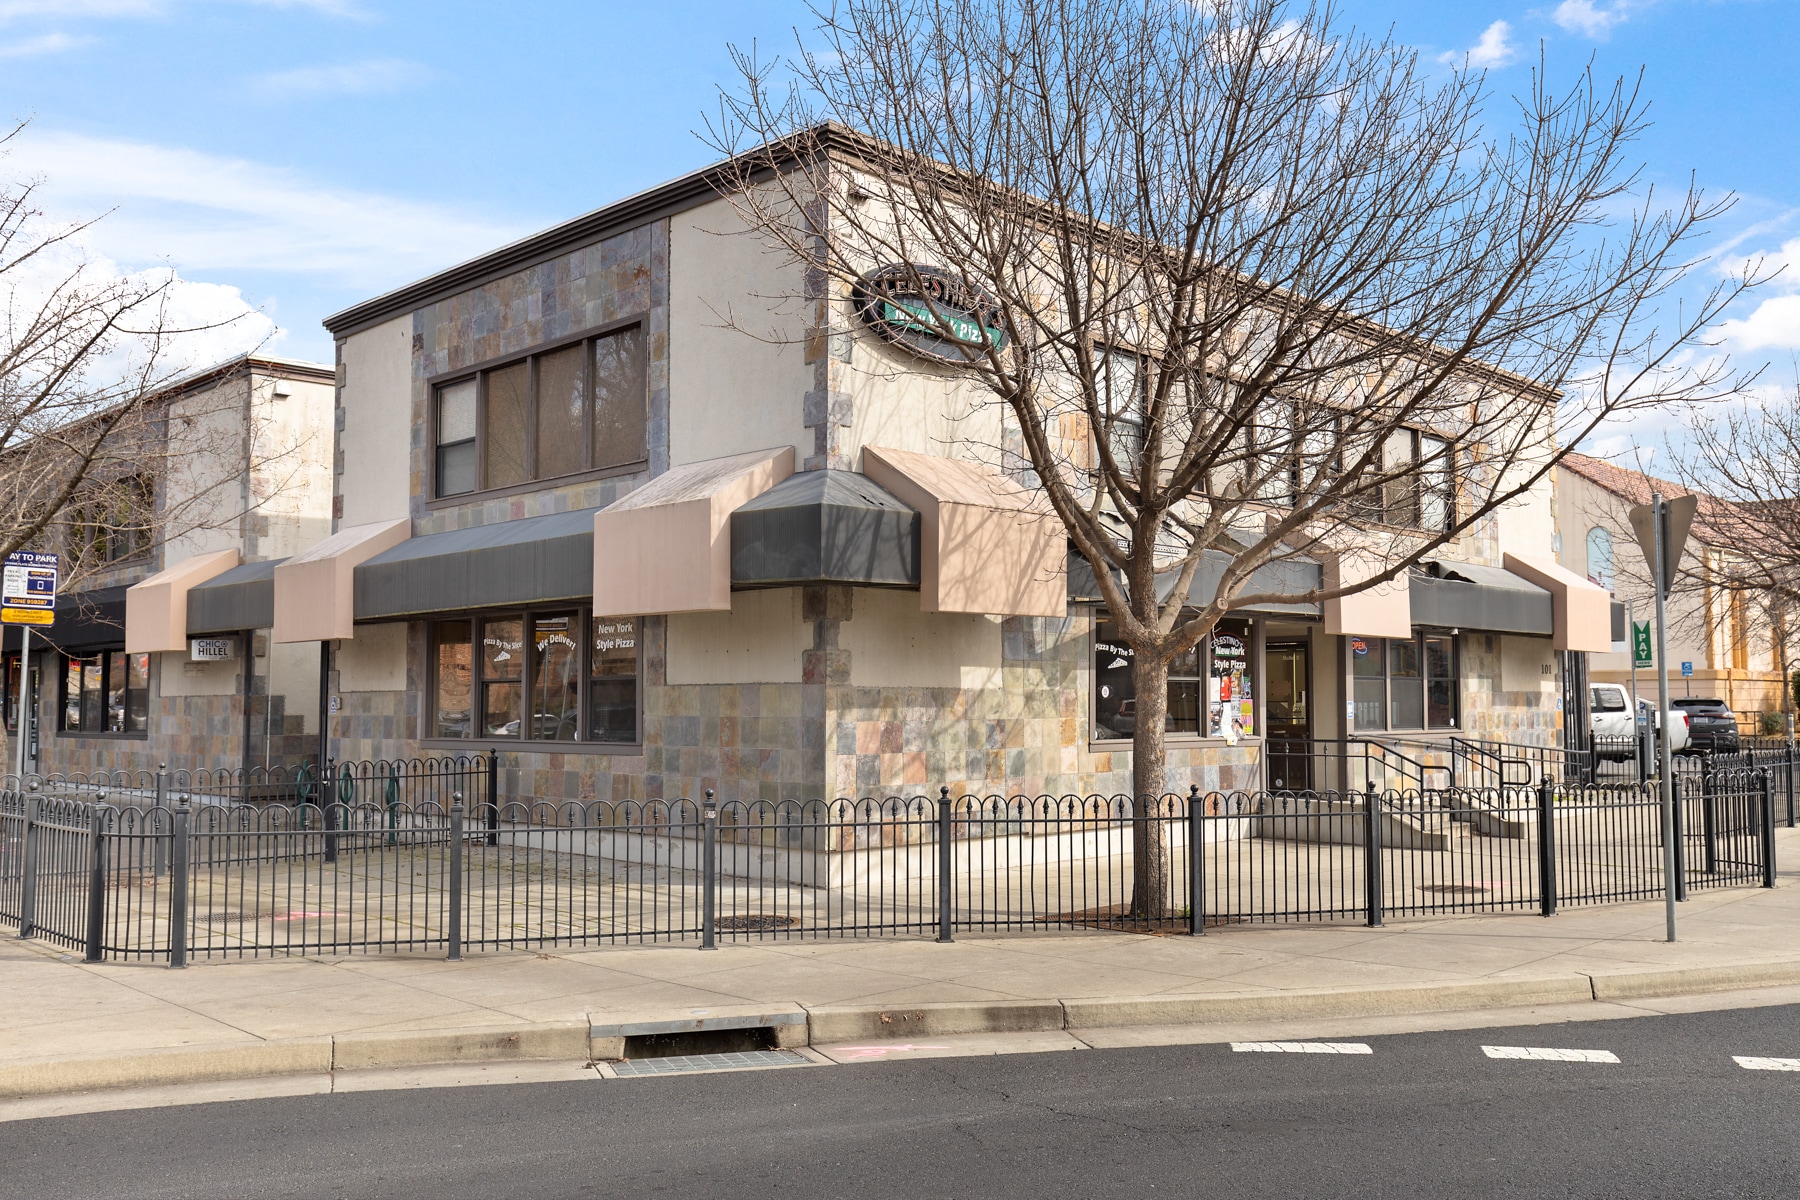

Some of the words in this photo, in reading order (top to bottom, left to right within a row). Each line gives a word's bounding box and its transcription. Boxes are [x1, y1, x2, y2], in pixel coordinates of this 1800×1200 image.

[598, 624, 615, 634] New
[616, 623, 633, 632] York
[198, 640, 228, 648] CHICO
[483, 638, 496, 646] Pizza
[496, 639, 503, 648] By
[503, 641, 511, 650] The
[537, 639, 549, 652] We
[549, 634, 576, 651] Deliver!
[597, 639, 614, 652] Style
[615, 639, 635, 648] Pizza
[1352, 641, 1366, 650] OPEN
[1639, 633, 1648, 659] PAY
[198, 648, 228, 656] HILLEL
[1095, 643, 1109, 651] Pizza
[1110, 644, 1117, 655] By
[1118, 647, 1128, 656] The
[1215, 646, 1230, 655] New
[1230, 646, 1245, 655] York
[1214, 660, 1230, 673] Style
[1230, 660, 1246, 669] Pizza
[1541, 664, 1552, 674] 101
